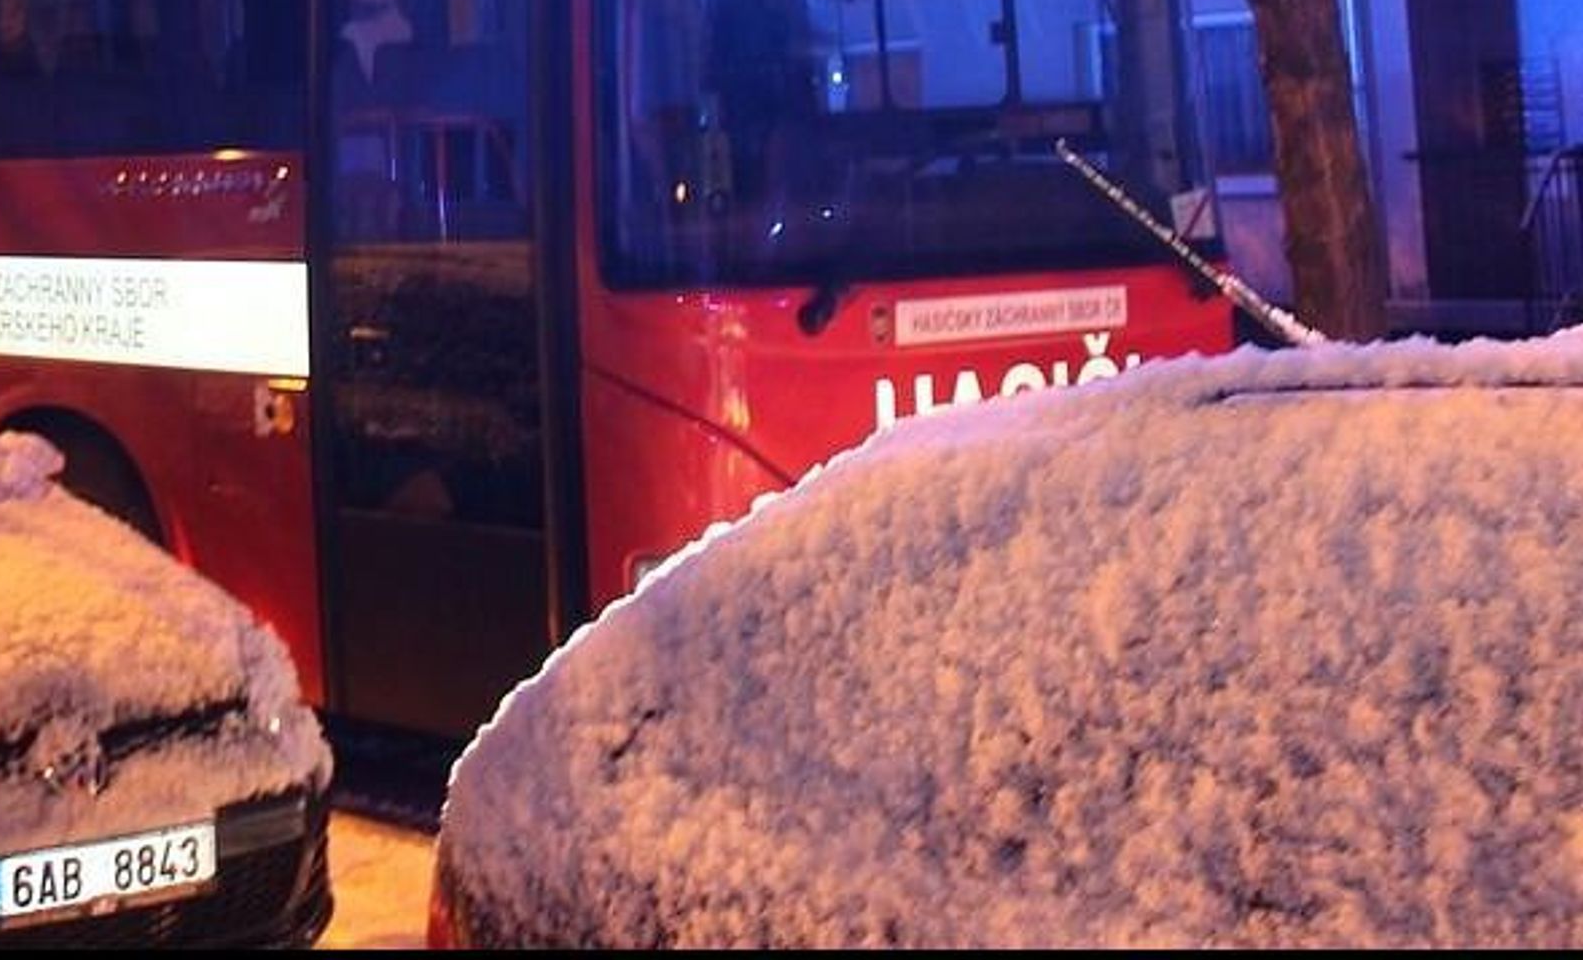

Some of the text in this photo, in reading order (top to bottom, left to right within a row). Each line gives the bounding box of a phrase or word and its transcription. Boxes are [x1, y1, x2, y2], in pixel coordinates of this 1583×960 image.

[111, 274, 169, 308] SBOR
[82, 316, 146, 349] KRAJE
[13, 837, 200, 908] 6AB 8843
